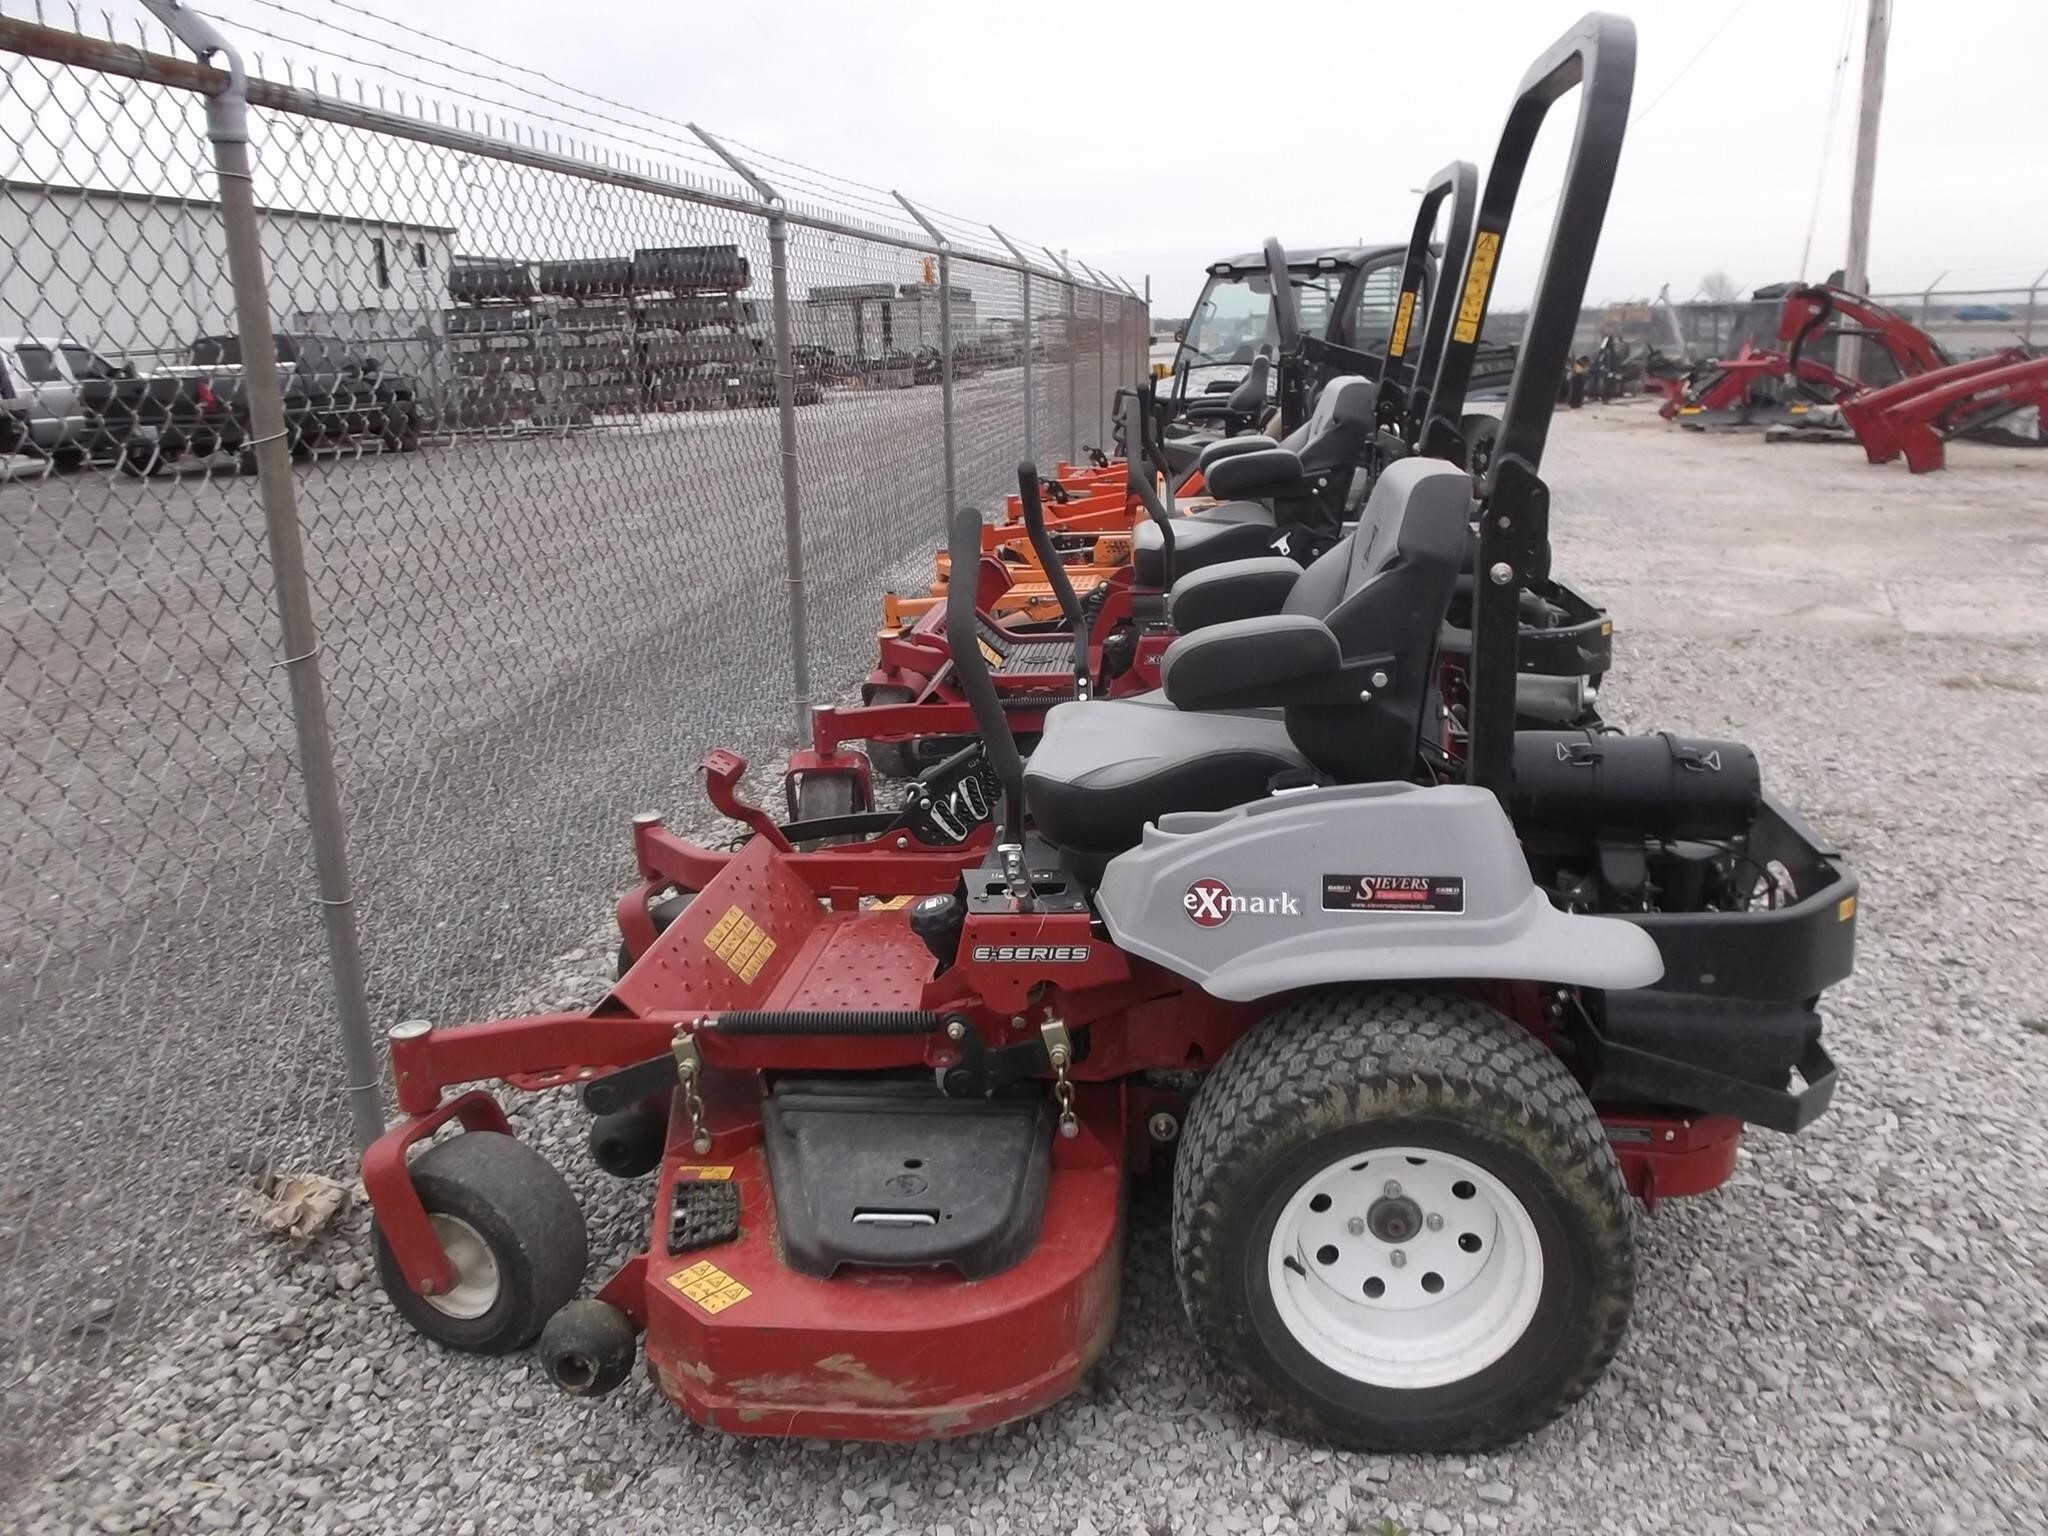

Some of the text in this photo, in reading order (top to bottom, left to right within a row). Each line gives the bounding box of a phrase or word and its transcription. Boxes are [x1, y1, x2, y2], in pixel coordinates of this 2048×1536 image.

[1356, 877, 1430, 900] SIEVERS
[1183, 887, 1298, 919] eXmark
[974, 947, 1089, 960] E-SERIES
